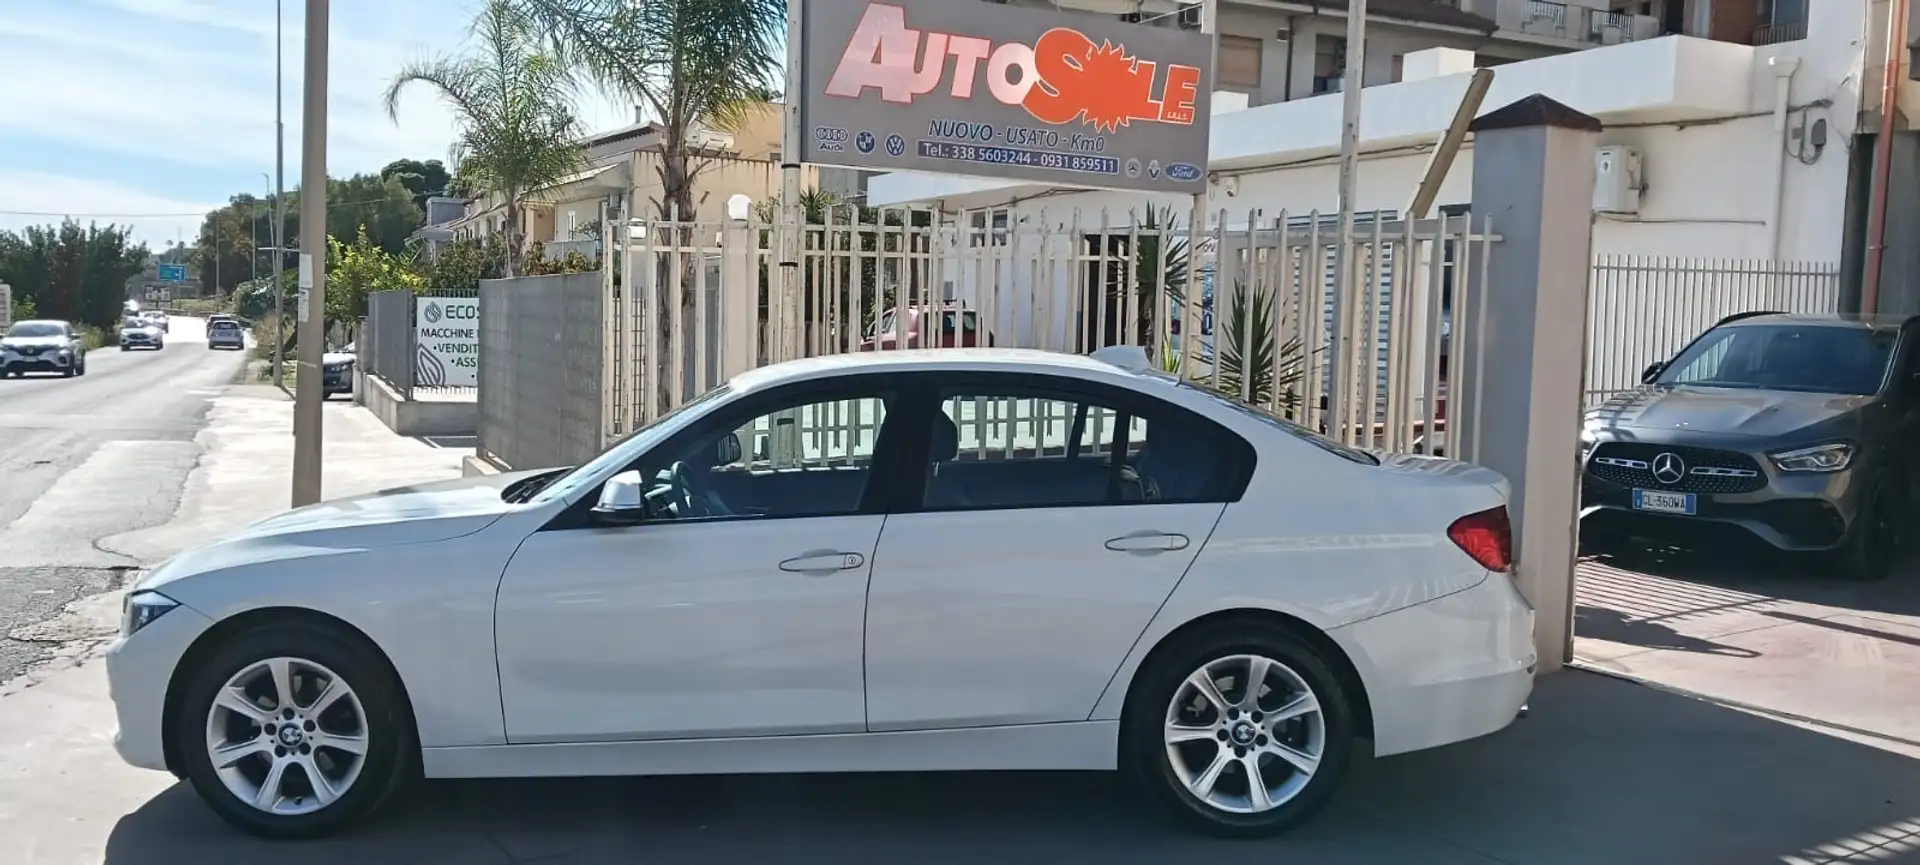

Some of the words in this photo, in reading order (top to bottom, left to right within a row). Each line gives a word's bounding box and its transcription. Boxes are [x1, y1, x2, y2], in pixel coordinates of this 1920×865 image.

[928, 119, 993, 141] NUOVO
[1006, 127, 1059, 148] USATO
[923, 143, 949, 157] Tel.:
[951, 145, 975, 160] 338
[979, 148, 1031, 165] 5603244
[1040, 154, 1070, 168] 0931
[1072, 157, 1114, 172] 859511
[421, 328, 475, 339] MACCHINE
